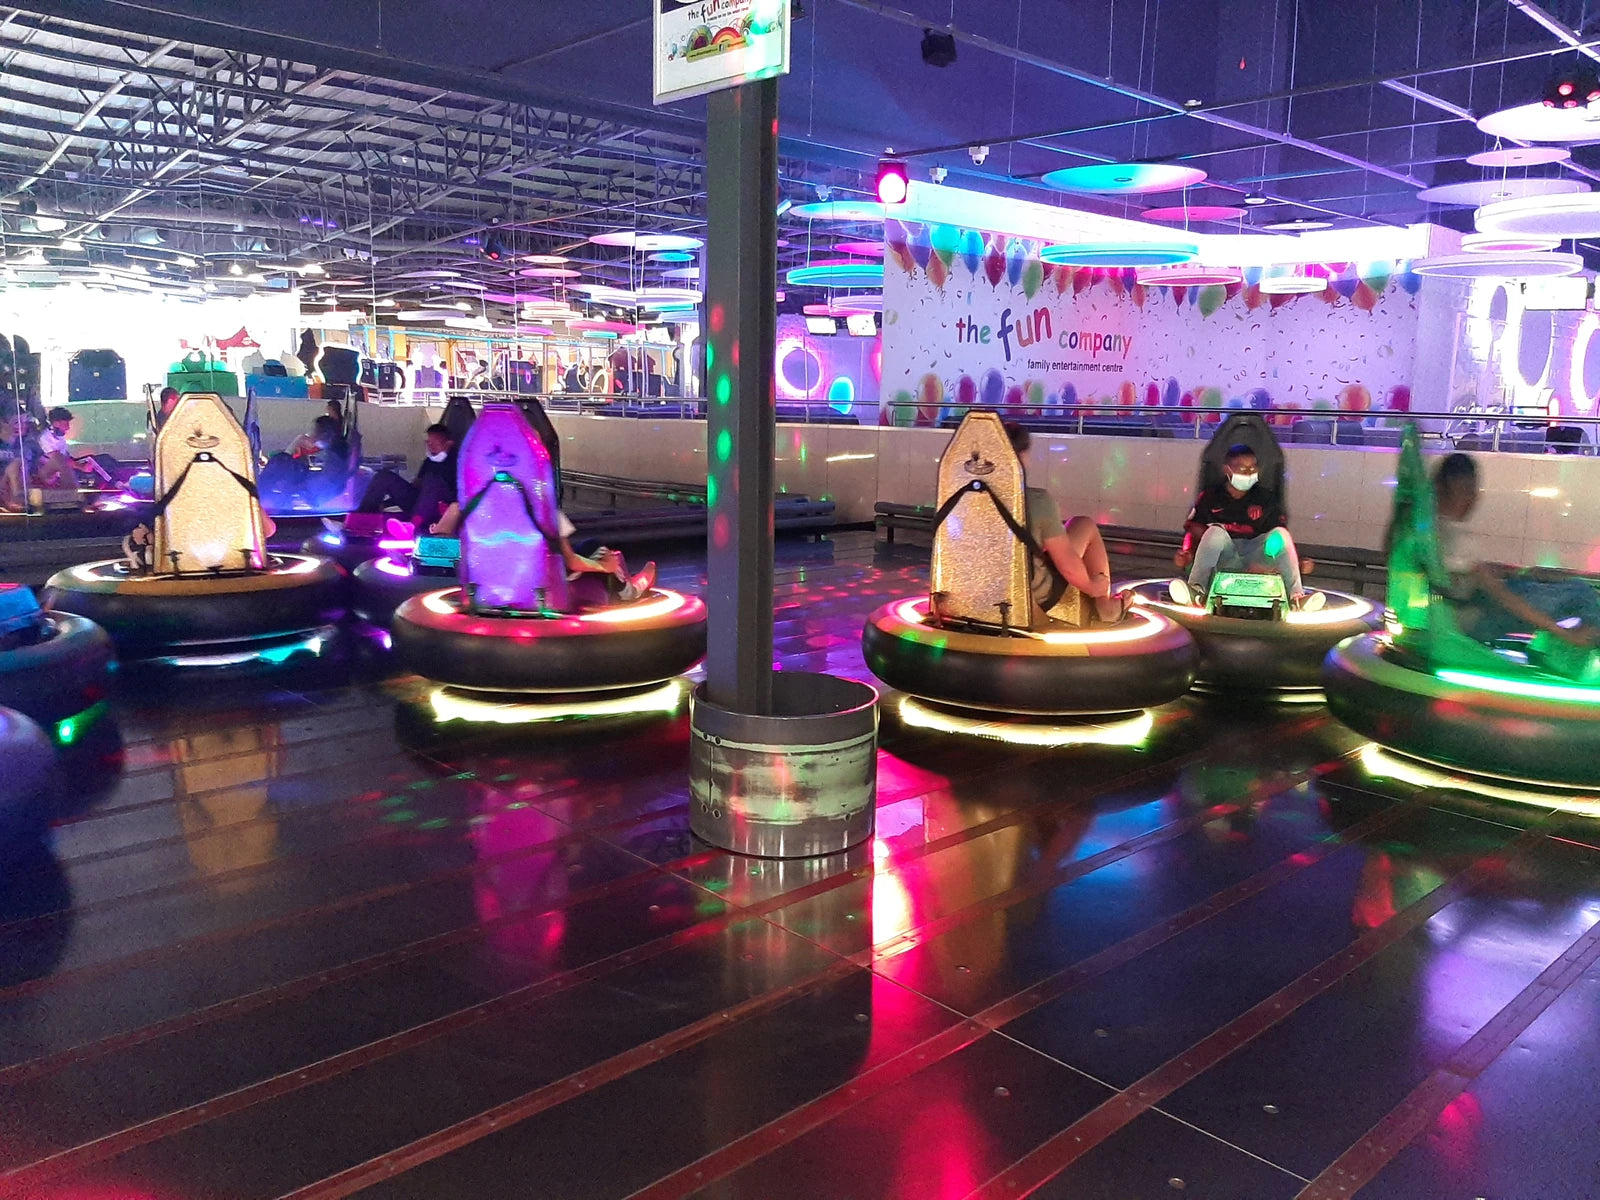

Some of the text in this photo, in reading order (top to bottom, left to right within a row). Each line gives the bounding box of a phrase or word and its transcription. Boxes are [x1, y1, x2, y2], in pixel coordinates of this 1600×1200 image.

[688, 9, 699, 20] the
[700, 0, 720, 23] fun
[956, 307, 1132, 361] the fun company
[1027, 359, 1124, 373] family entertainment centre
